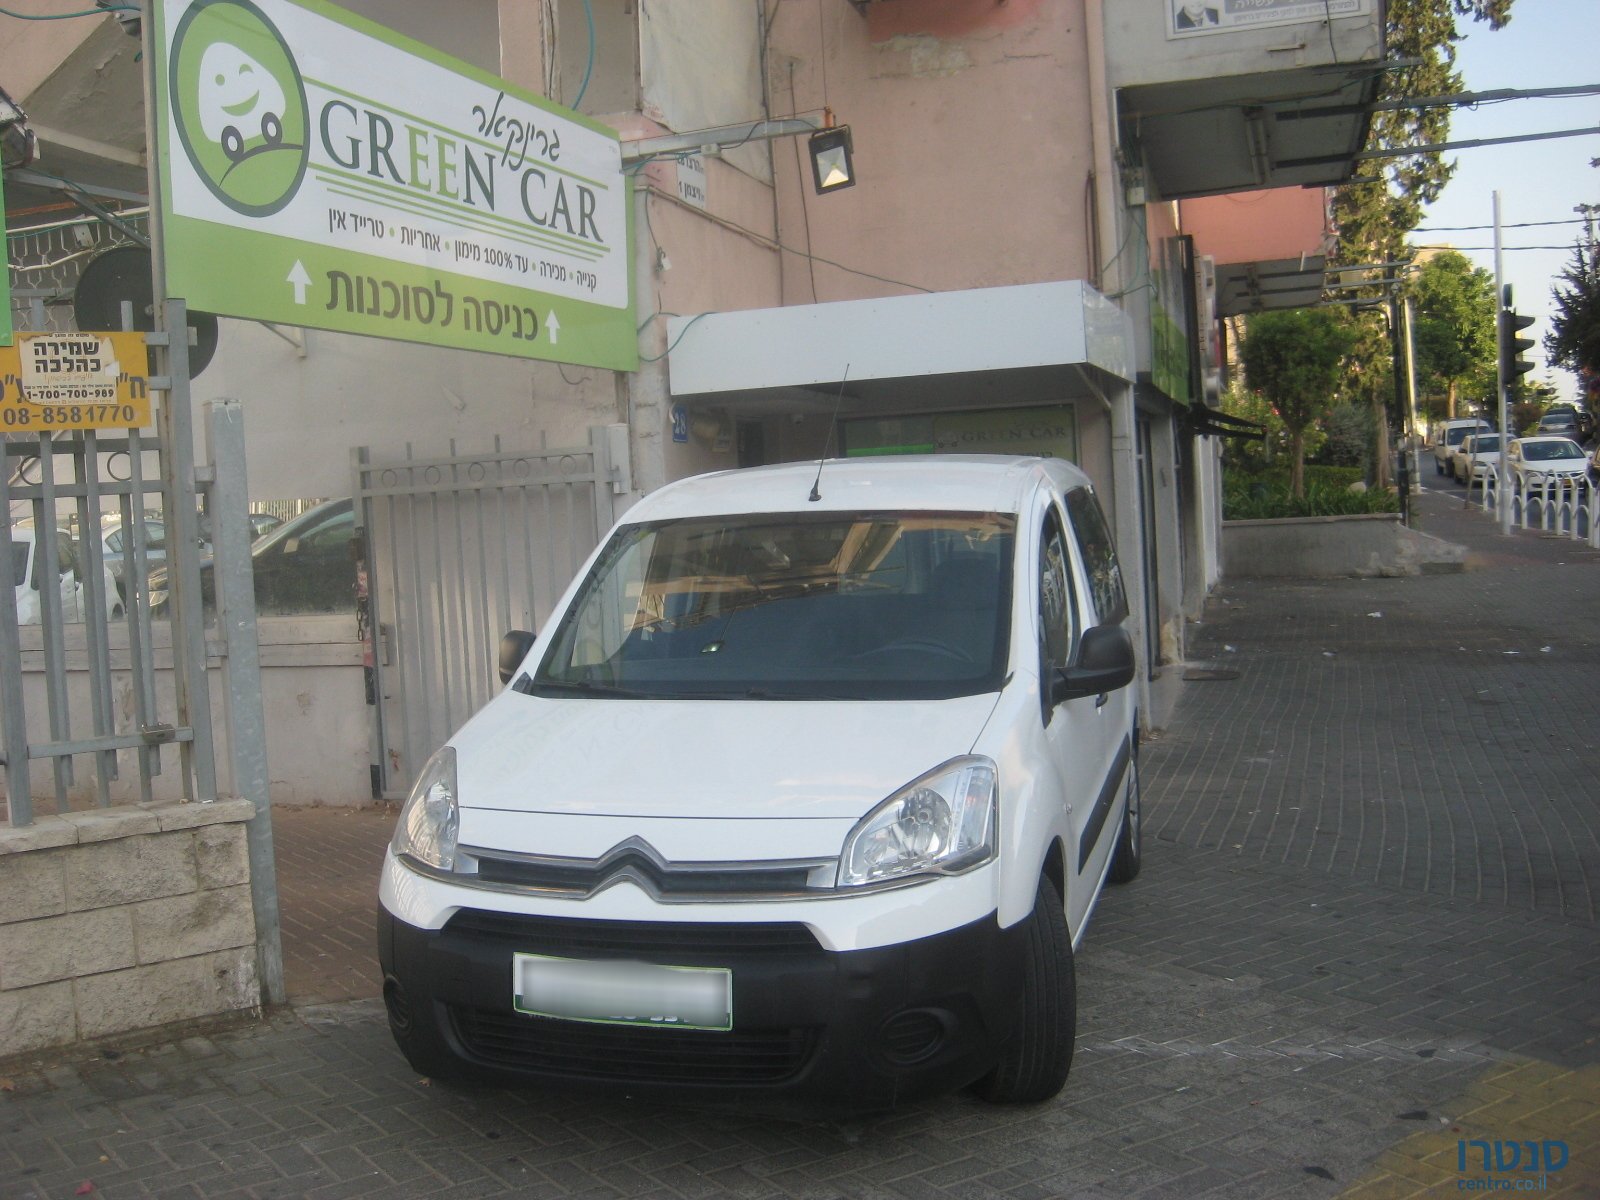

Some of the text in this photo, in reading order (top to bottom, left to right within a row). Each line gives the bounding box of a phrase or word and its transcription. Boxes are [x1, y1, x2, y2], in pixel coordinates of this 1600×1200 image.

[472, 90, 560, 171] גרינקאר
[320, 100, 604, 243] GREEN CAR
[328, 208, 597, 293] קנייה מכירה עד 100% מימון אחריות טרייד אין
[326, 270, 539, 341] כניסה לסוכנות
[34, 342, 100, 356] שמירה
[35, 357, 102, 373] כהלכה
[3, 405, 135, 426] 08-8581770
[675, 412, 686, 435] 28
[1030, 426, 1066, 439] CAR
